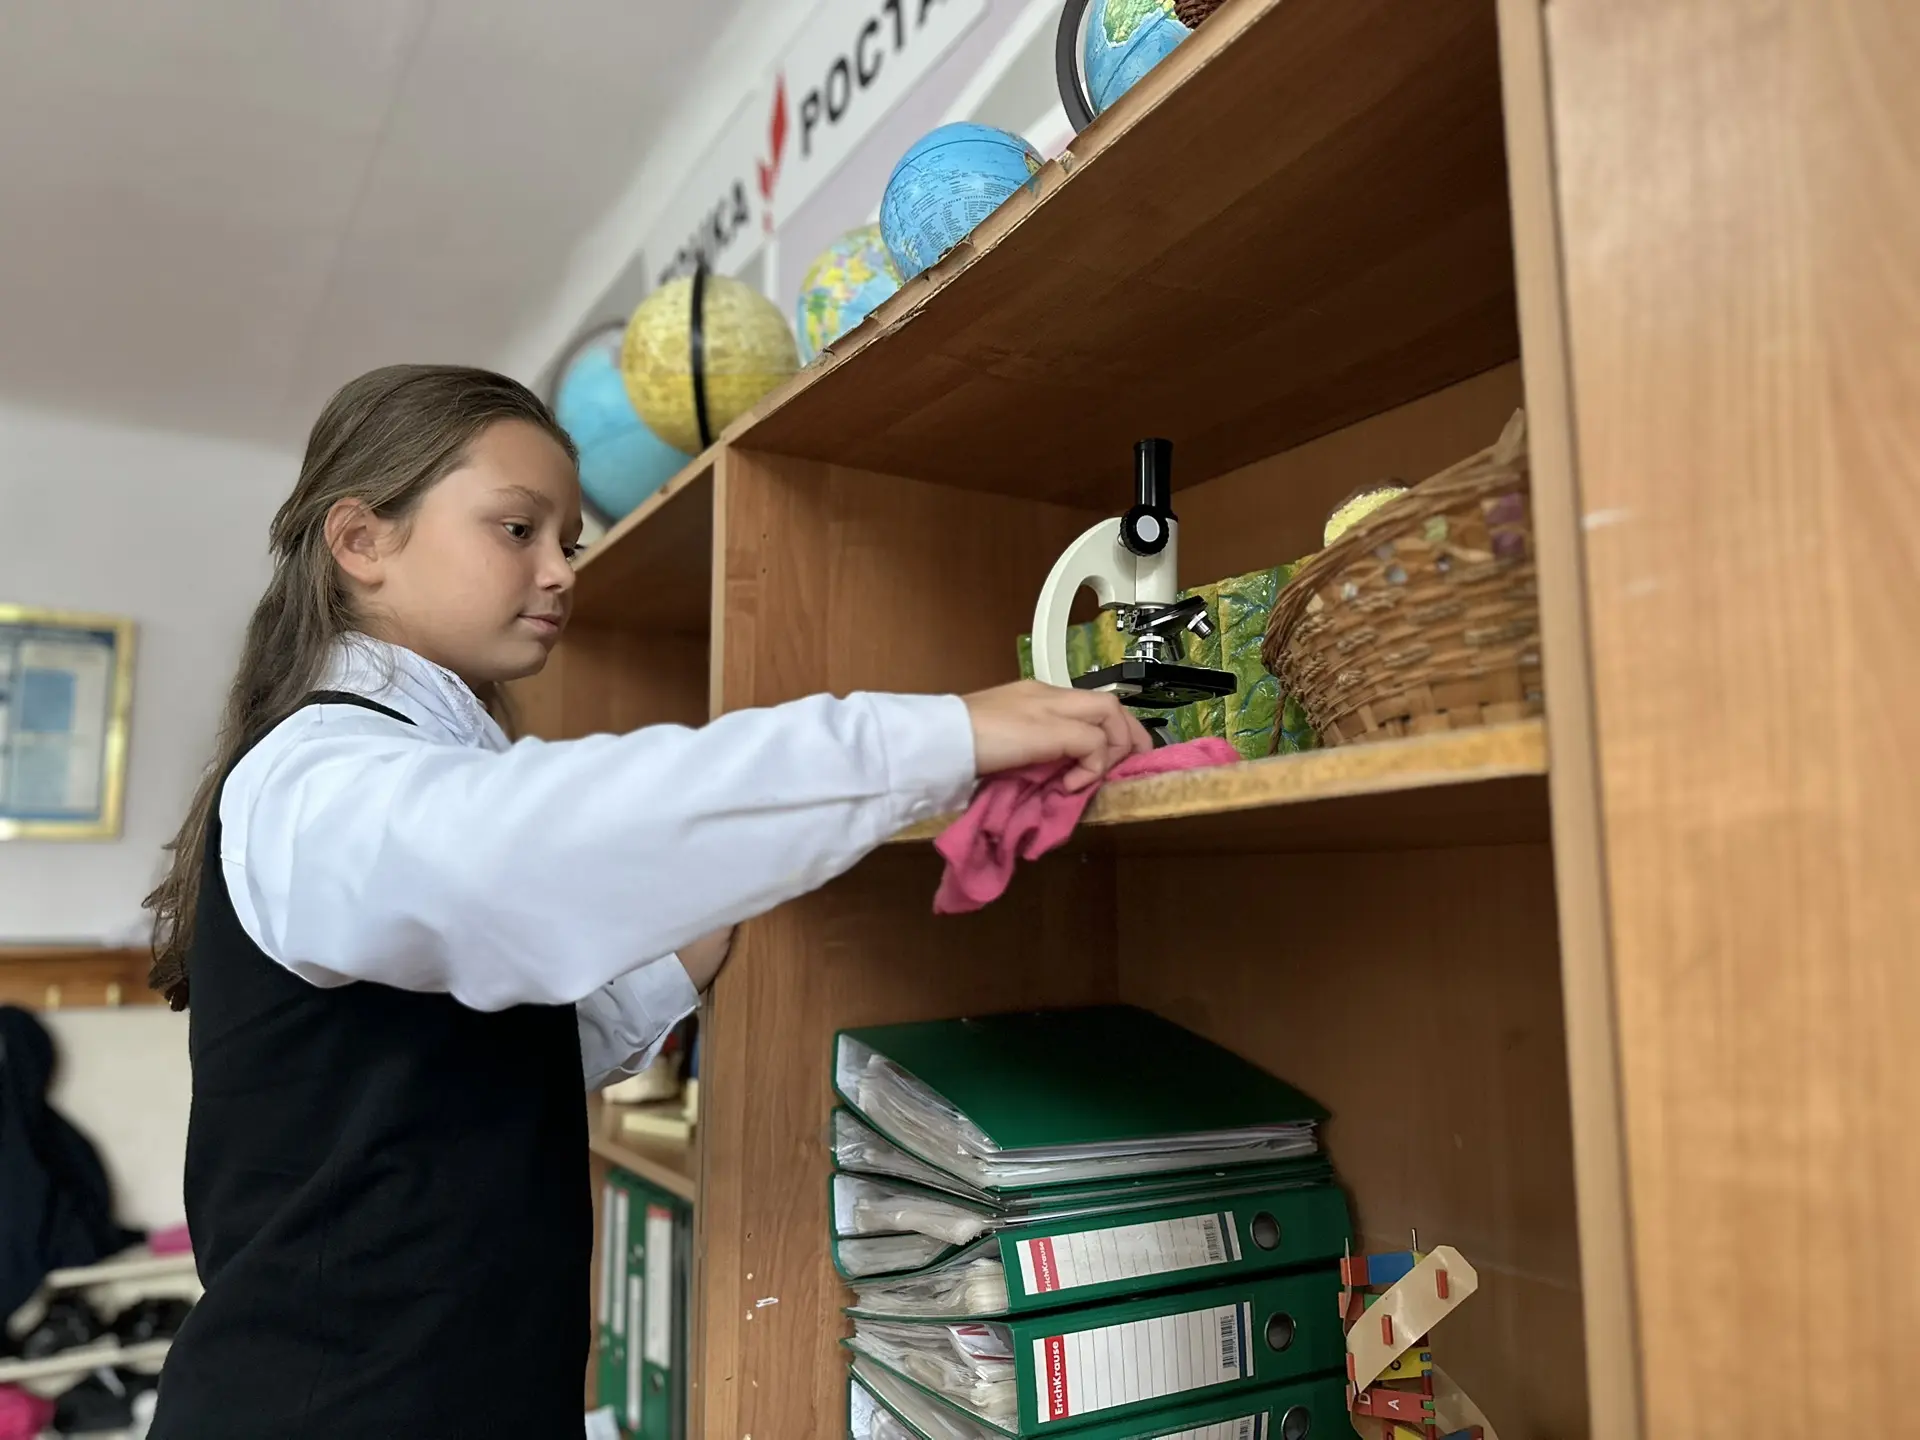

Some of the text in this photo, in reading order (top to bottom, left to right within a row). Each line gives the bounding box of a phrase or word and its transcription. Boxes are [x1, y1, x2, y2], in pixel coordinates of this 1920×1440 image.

[1039, 1241, 1052, 1292] ErichKrause
[1052, 1341, 1063, 1415] ErichKrause
[1388, 1399, 1400, 1411] A
